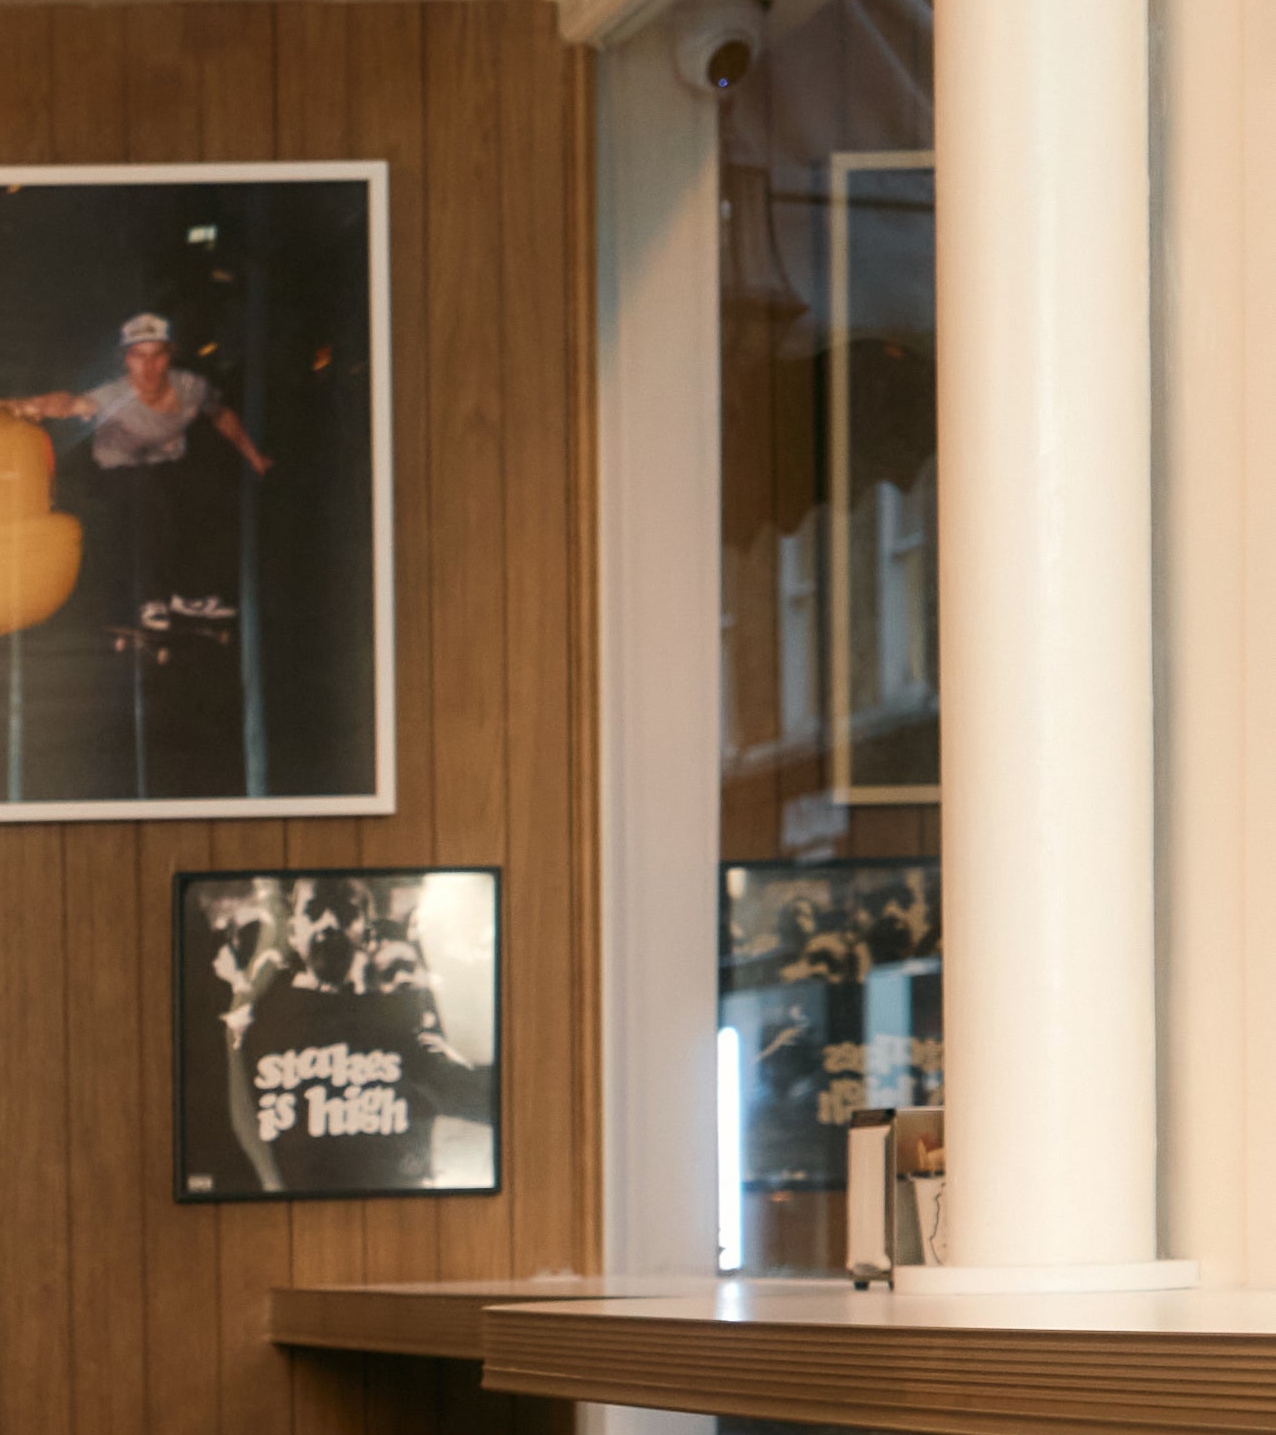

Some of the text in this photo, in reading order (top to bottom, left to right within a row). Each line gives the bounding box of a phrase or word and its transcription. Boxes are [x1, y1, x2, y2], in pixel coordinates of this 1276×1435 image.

[253, 1042, 403, 1091] stakes
[256, 1084, 410, 1142] is high
